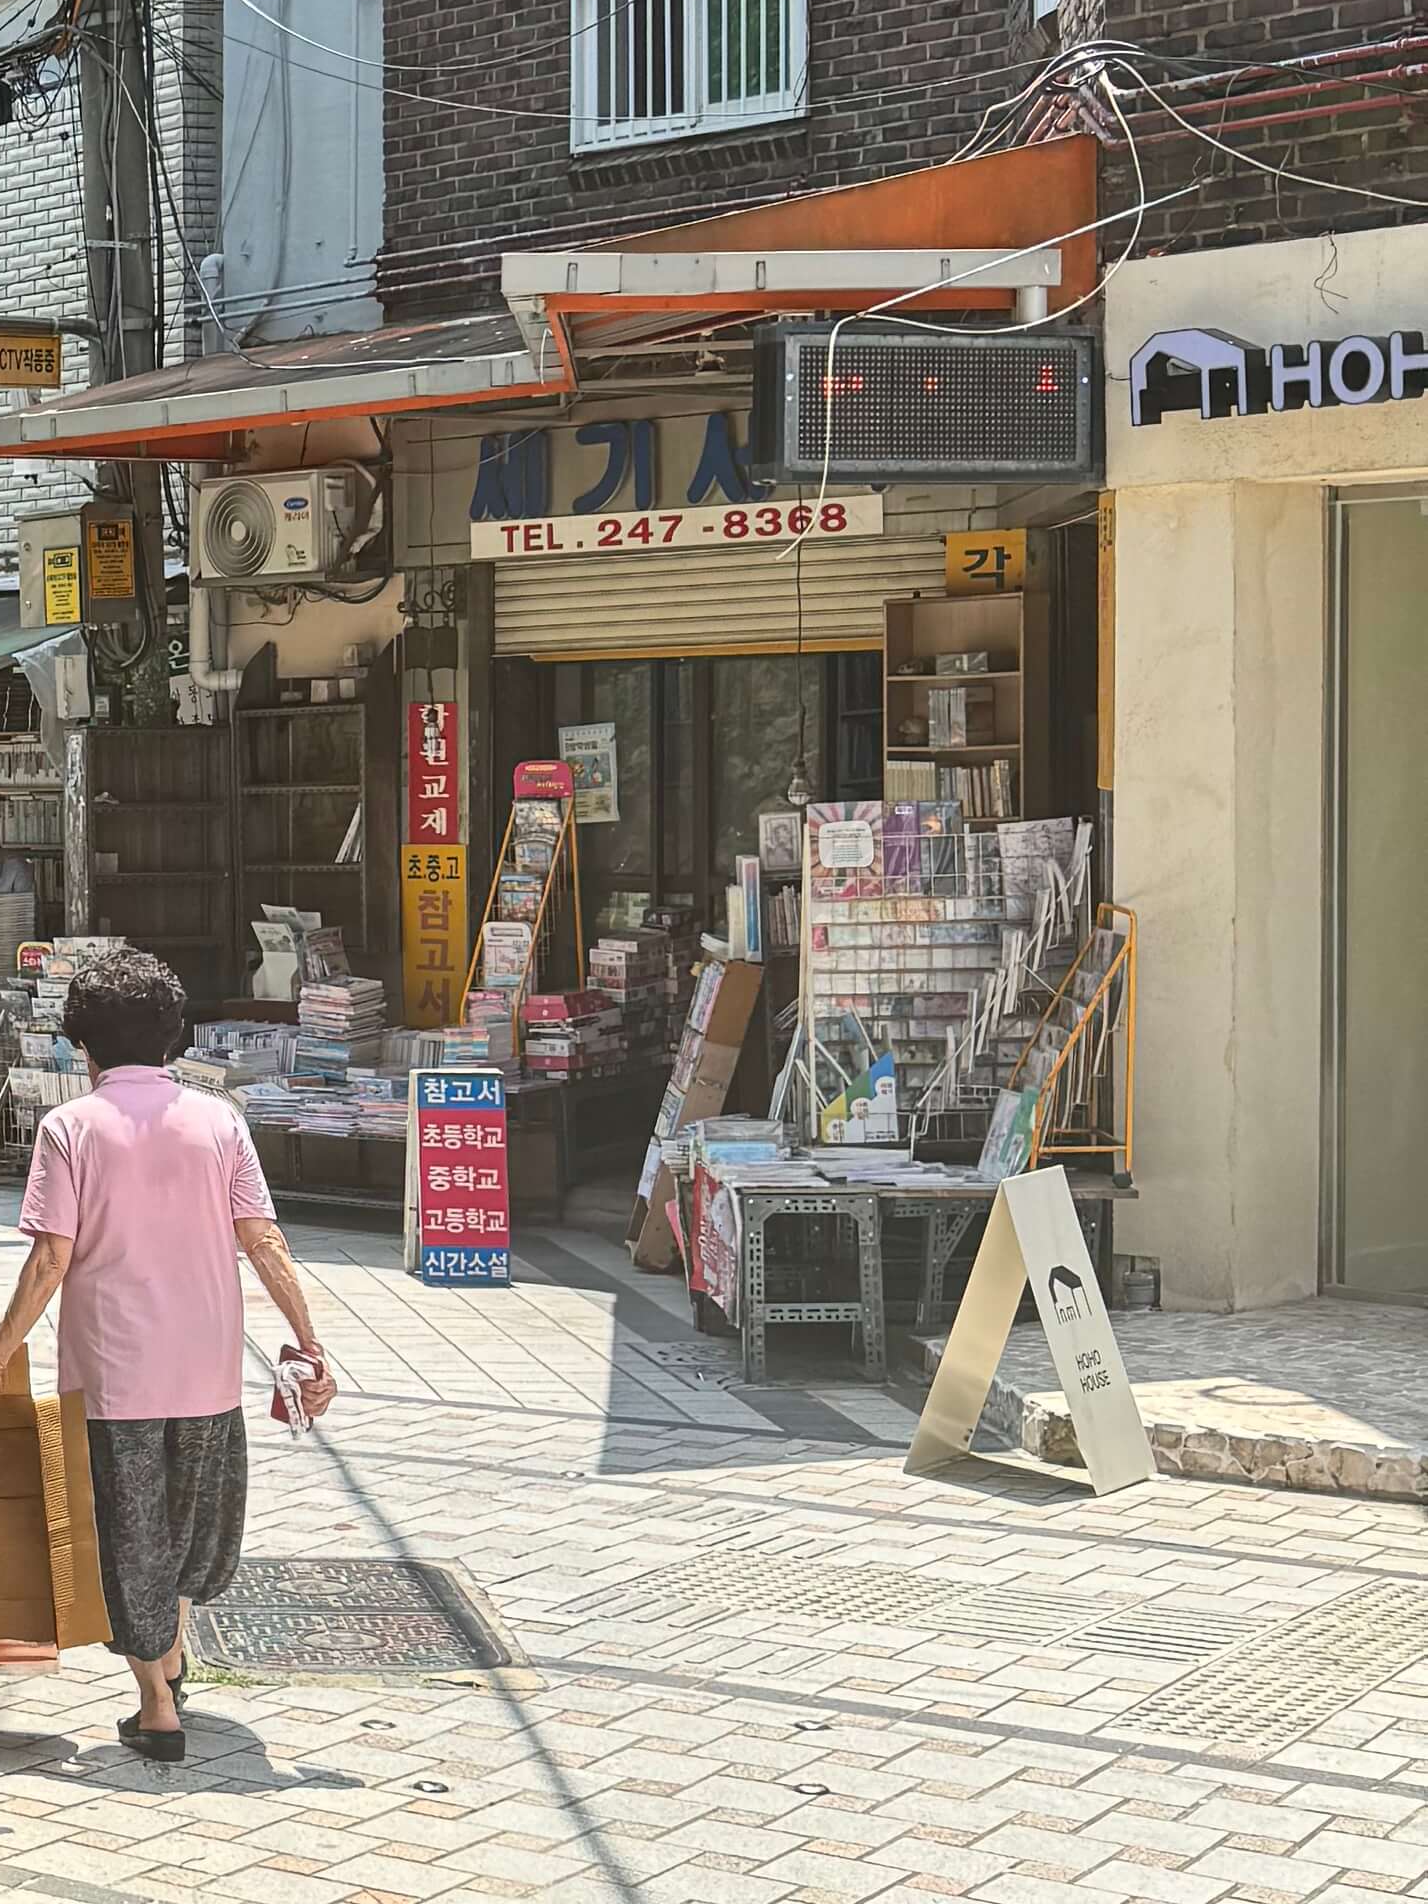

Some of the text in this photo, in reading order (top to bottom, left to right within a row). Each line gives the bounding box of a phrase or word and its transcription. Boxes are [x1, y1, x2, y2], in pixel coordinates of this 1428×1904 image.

[596, 514, 684, 548] 247
[414, 887, 456, 1029] 참고서
[421, 1076, 503, 1107] 참고서
[421, 1123, 506, 1151] 초등학교
[426, 1163, 503, 1193] 중학교
[423, 1205, 509, 1234] 고등학교
[424, 1247, 510, 1281] 신간소설
[1075, 1348, 1102, 1372] HOHO
[1080, 1369, 1111, 1394] HOUSE
